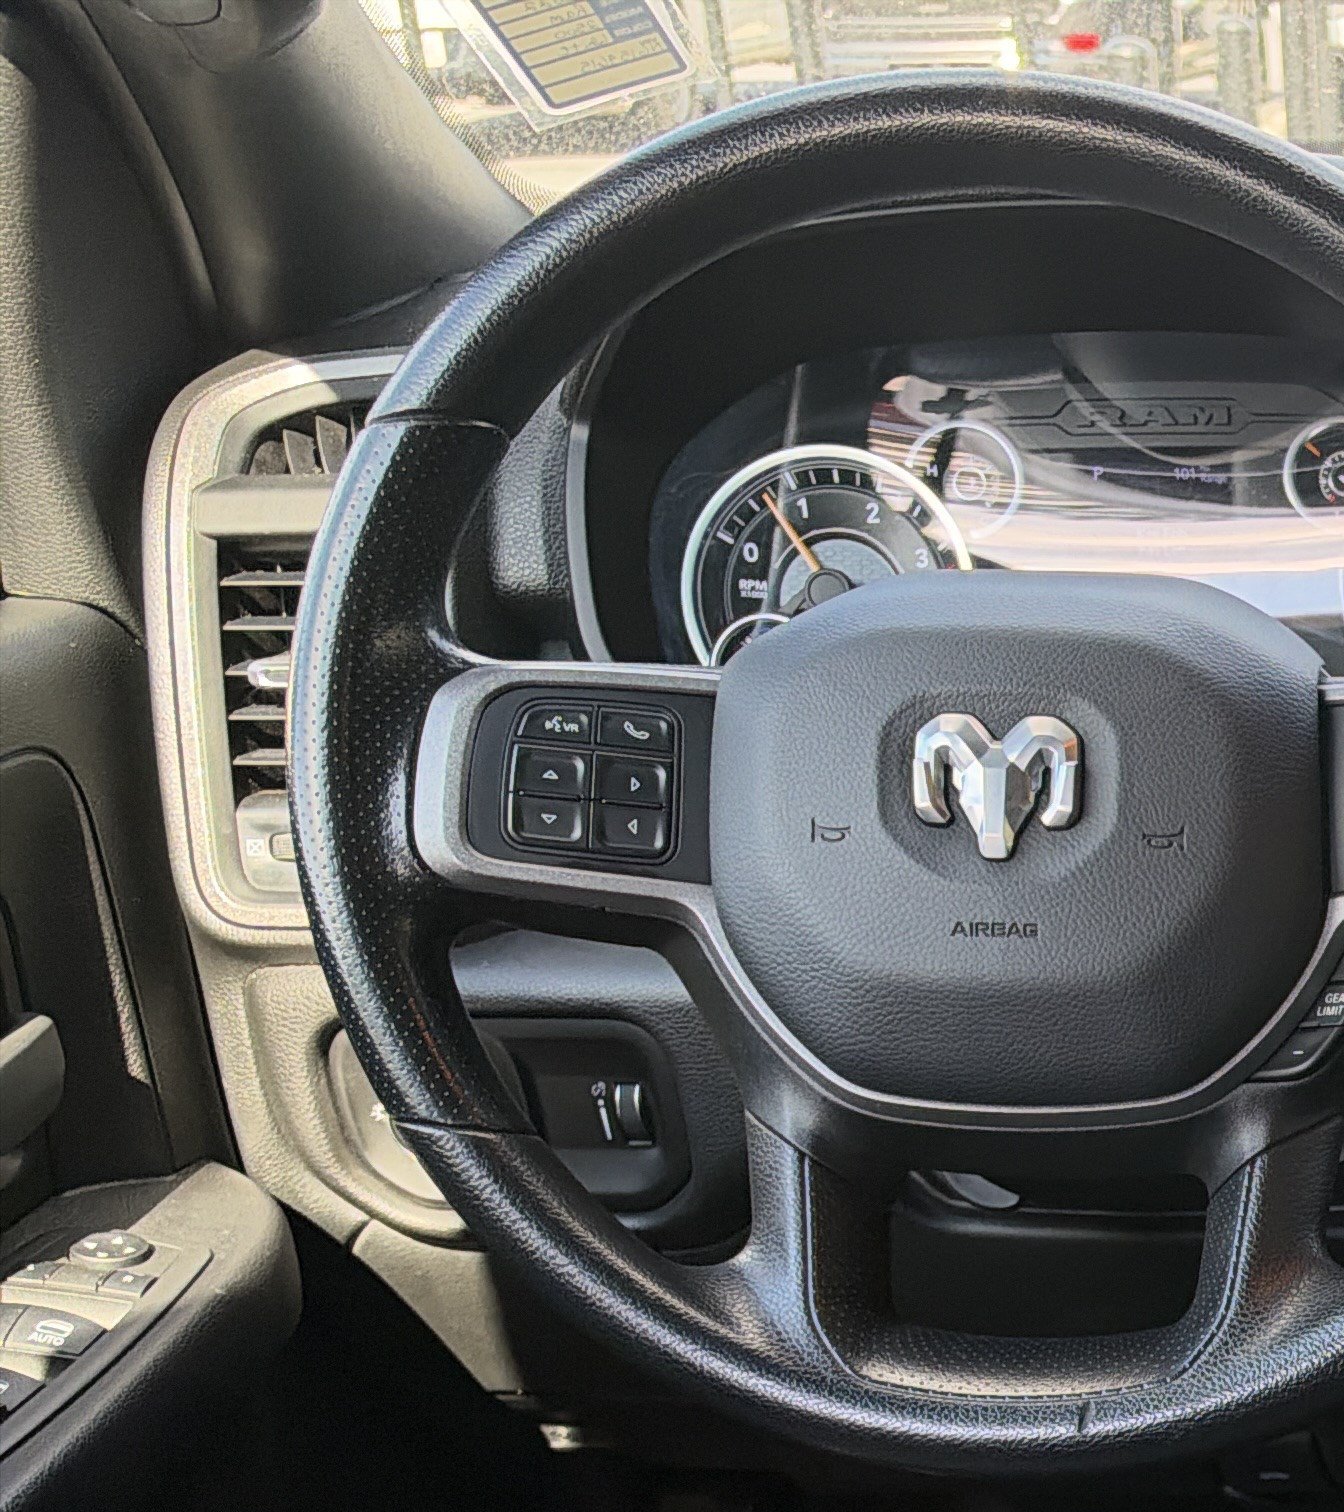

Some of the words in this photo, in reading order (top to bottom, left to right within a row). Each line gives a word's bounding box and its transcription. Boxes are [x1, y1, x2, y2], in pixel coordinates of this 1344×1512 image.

[1077, 405, 1231, 428] RAM
[1092, 466, 1104, 480] P
[796, 498, 809, 518] 1
[864, 502, 881, 524] 2
[743, 542, 759, 563] 0
[914, 548, 929, 568] 3
[738, 578, 768, 590] RPM
[563, 722, 579, 733] VR
[950, 921, 1038, 939] AIRBAG
[1317, 1005, 1344, 1017] LIMIT
[27, 1331, 65, 1347] AUTO
